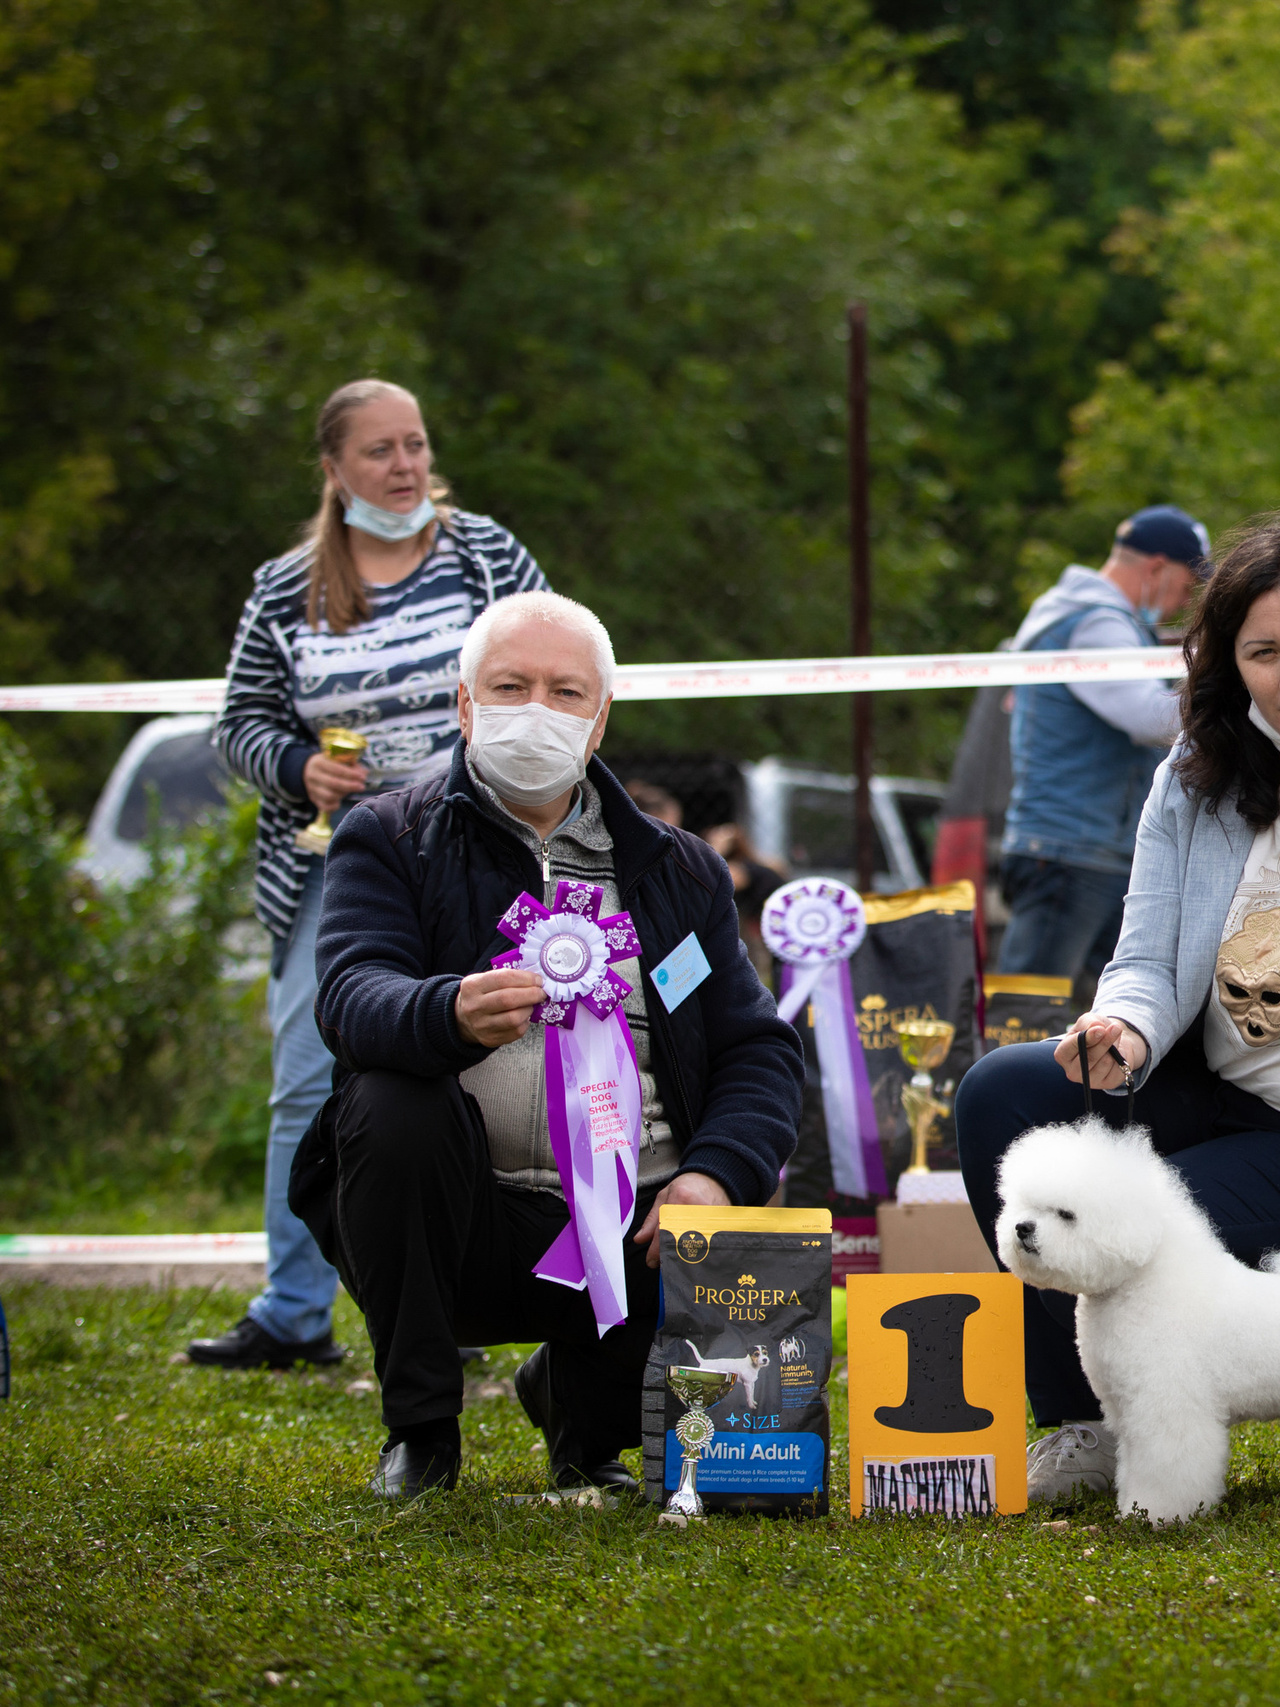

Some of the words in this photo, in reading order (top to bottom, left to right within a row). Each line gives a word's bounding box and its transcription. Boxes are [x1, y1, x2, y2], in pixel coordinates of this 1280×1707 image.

[580, 1079, 620, 1095] SPECIAL
[591, 1092, 612, 1104] DOG
[588, 1101, 619, 1115] SHOW
[694, 1285, 802, 1306] PROSPERA
[728, 1306, 767, 1321] PLUS
[780, 1363, 808, 1373] Natural
[874, 1293, 994, 1433] 1
[780, 1370, 815, 1379] immunity
[742, 1412, 781, 1430] SIZE
[704, 1442, 746, 1460] Mini
[750, 1443, 801, 1460] Adult
[867, 1458, 993, 1519] МАГНИТКА
